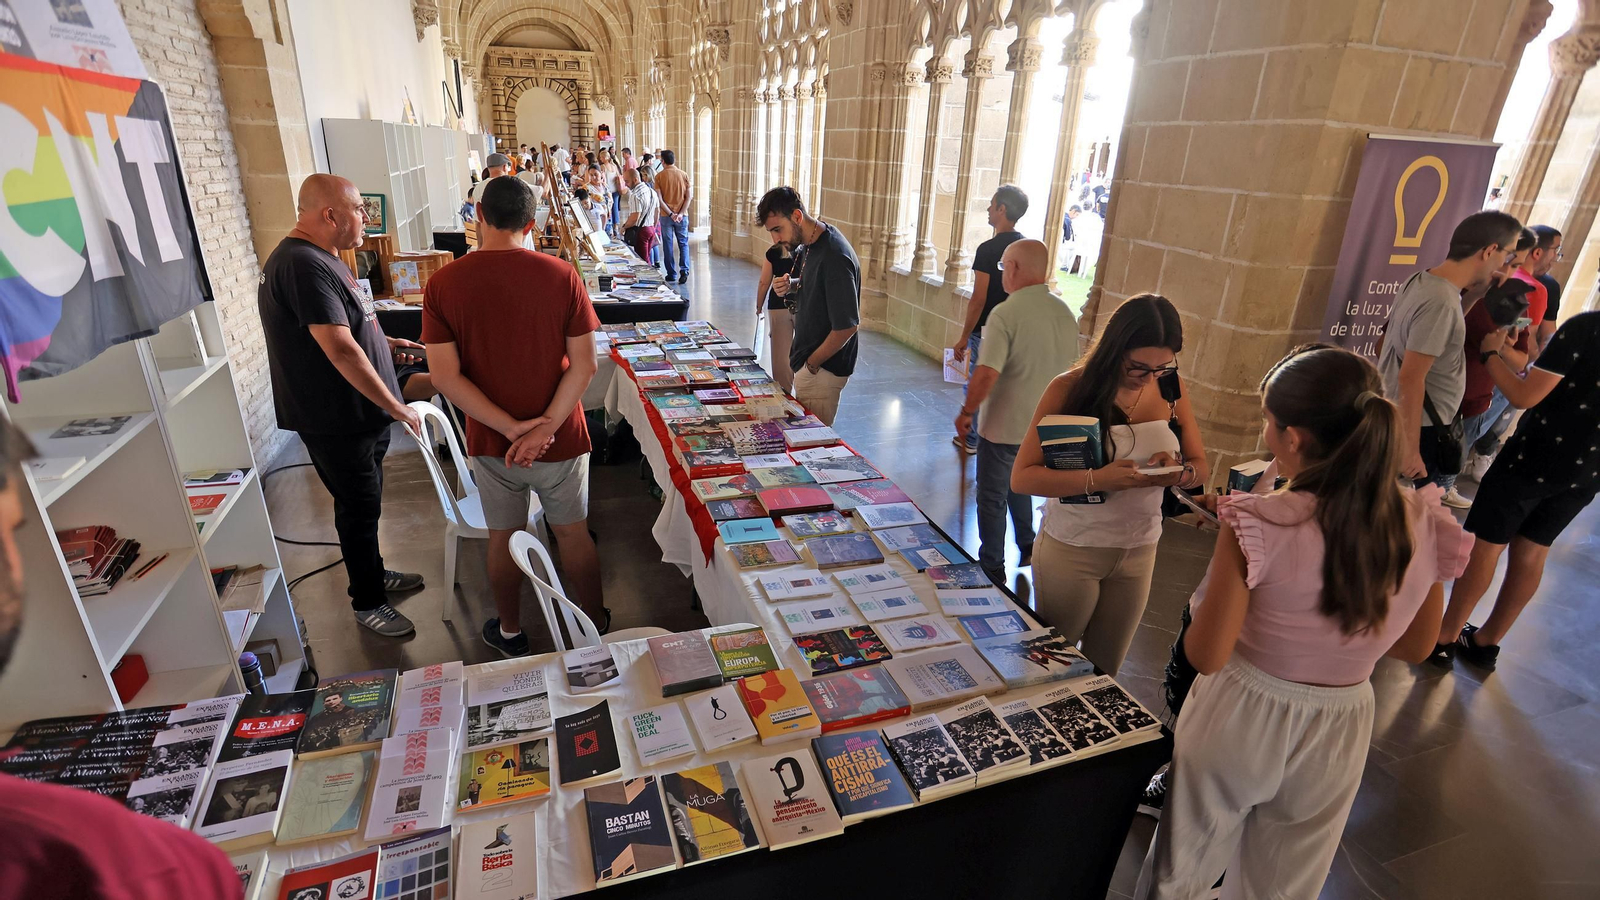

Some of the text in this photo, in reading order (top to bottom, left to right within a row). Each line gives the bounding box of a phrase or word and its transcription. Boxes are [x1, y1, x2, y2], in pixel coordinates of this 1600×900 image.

[1368, 281, 1403, 295] Cont
[1346, 301, 1392, 319] la luz y
[1330, 322, 1347, 336] de
[1351, 323, 1365, 336] tu
[662, 640, 684, 648] CNT
[724, 656, 760, 667] EUROPA
[513, 670, 541, 679] VIVIR
[513, 676, 543, 685] DONDE
[502, 681, 543, 693] QUIERAS
[822, 692, 834, 709] Gijón
[964, 699, 984, 709] BLANCO
[115, 718, 143, 726] Mano
[633, 711, 654, 721] FUCK
[634, 716, 661, 727] GREEN
[241, 719, 299, 731] M.E.N.A.
[636, 723, 655, 733] NEW
[638, 729, 660, 739] DEAL
[845, 736, 861, 746] ARUN
[847, 739, 878, 752] KUNDNANI
[826, 746, 882, 769] QUÉ ES EL
[74, 768, 106, 777] Mano
[831, 756, 891, 781] ANTIRRA-
[173, 771, 199, 780] BLANCO
[498, 777, 534, 786] Caminando
[507, 781, 535, 790] paraguas
[834, 771, 875, 794] CISMO
[852, 788, 861, 796] POR
[870, 778, 892, 789] SIGNIFICA
[849, 785, 889, 802] ANTICAPITALISMO
[686, 794, 725, 808] MUGA
[773, 798, 810, 810] configuración
[772, 813, 803, 823] anarquista
[806, 806, 826, 816] México
[776, 802, 817, 817] pensamiento
[605, 810, 650, 828] BASTAN
[607, 820, 651, 834] CINCO MINUTOS
[482, 853, 513, 864] Renta
[482, 860, 513, 872] Básica
[481, 867, 513, 892] 2
